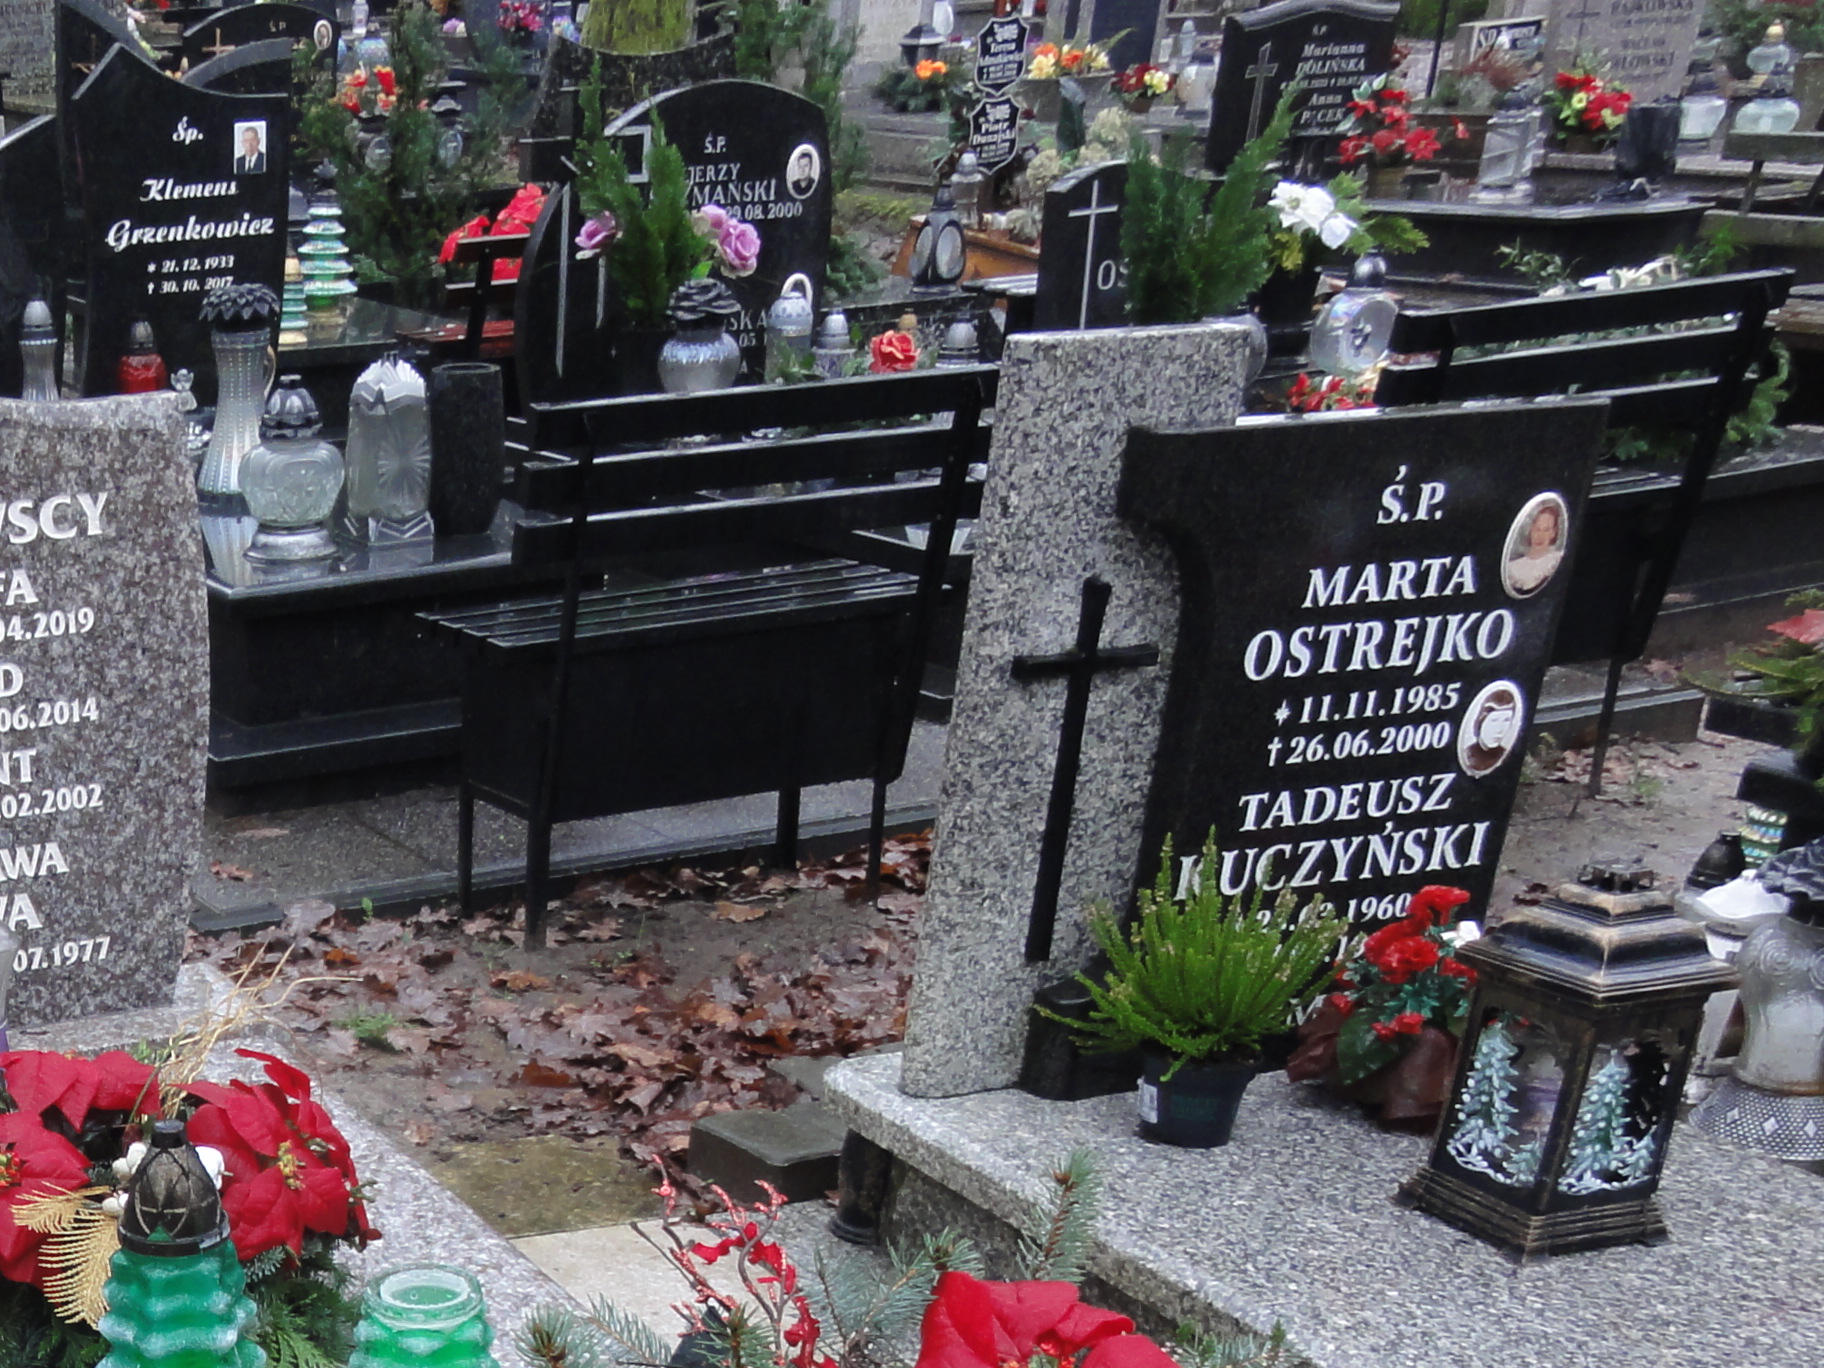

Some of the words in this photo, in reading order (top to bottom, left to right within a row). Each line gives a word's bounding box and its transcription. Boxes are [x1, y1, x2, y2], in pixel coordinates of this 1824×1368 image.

[139, 177, 239, 202] Klemens
[687, 163, 741, 186] JERZY
[105, 212, 275, 252] Grzenkowicz
[1376, 465, 1446, 525] Ś.P.
[1301, 554, 1478, 609] MARTA
[1243, 608, 1515, 681] OSTREJKO
[1299, 682, 1461, 725] 11.11.1985
[1285, 721, 1452, 766] 26.06.2000
[1238, 772, 1458, 832] TADEUSZ
